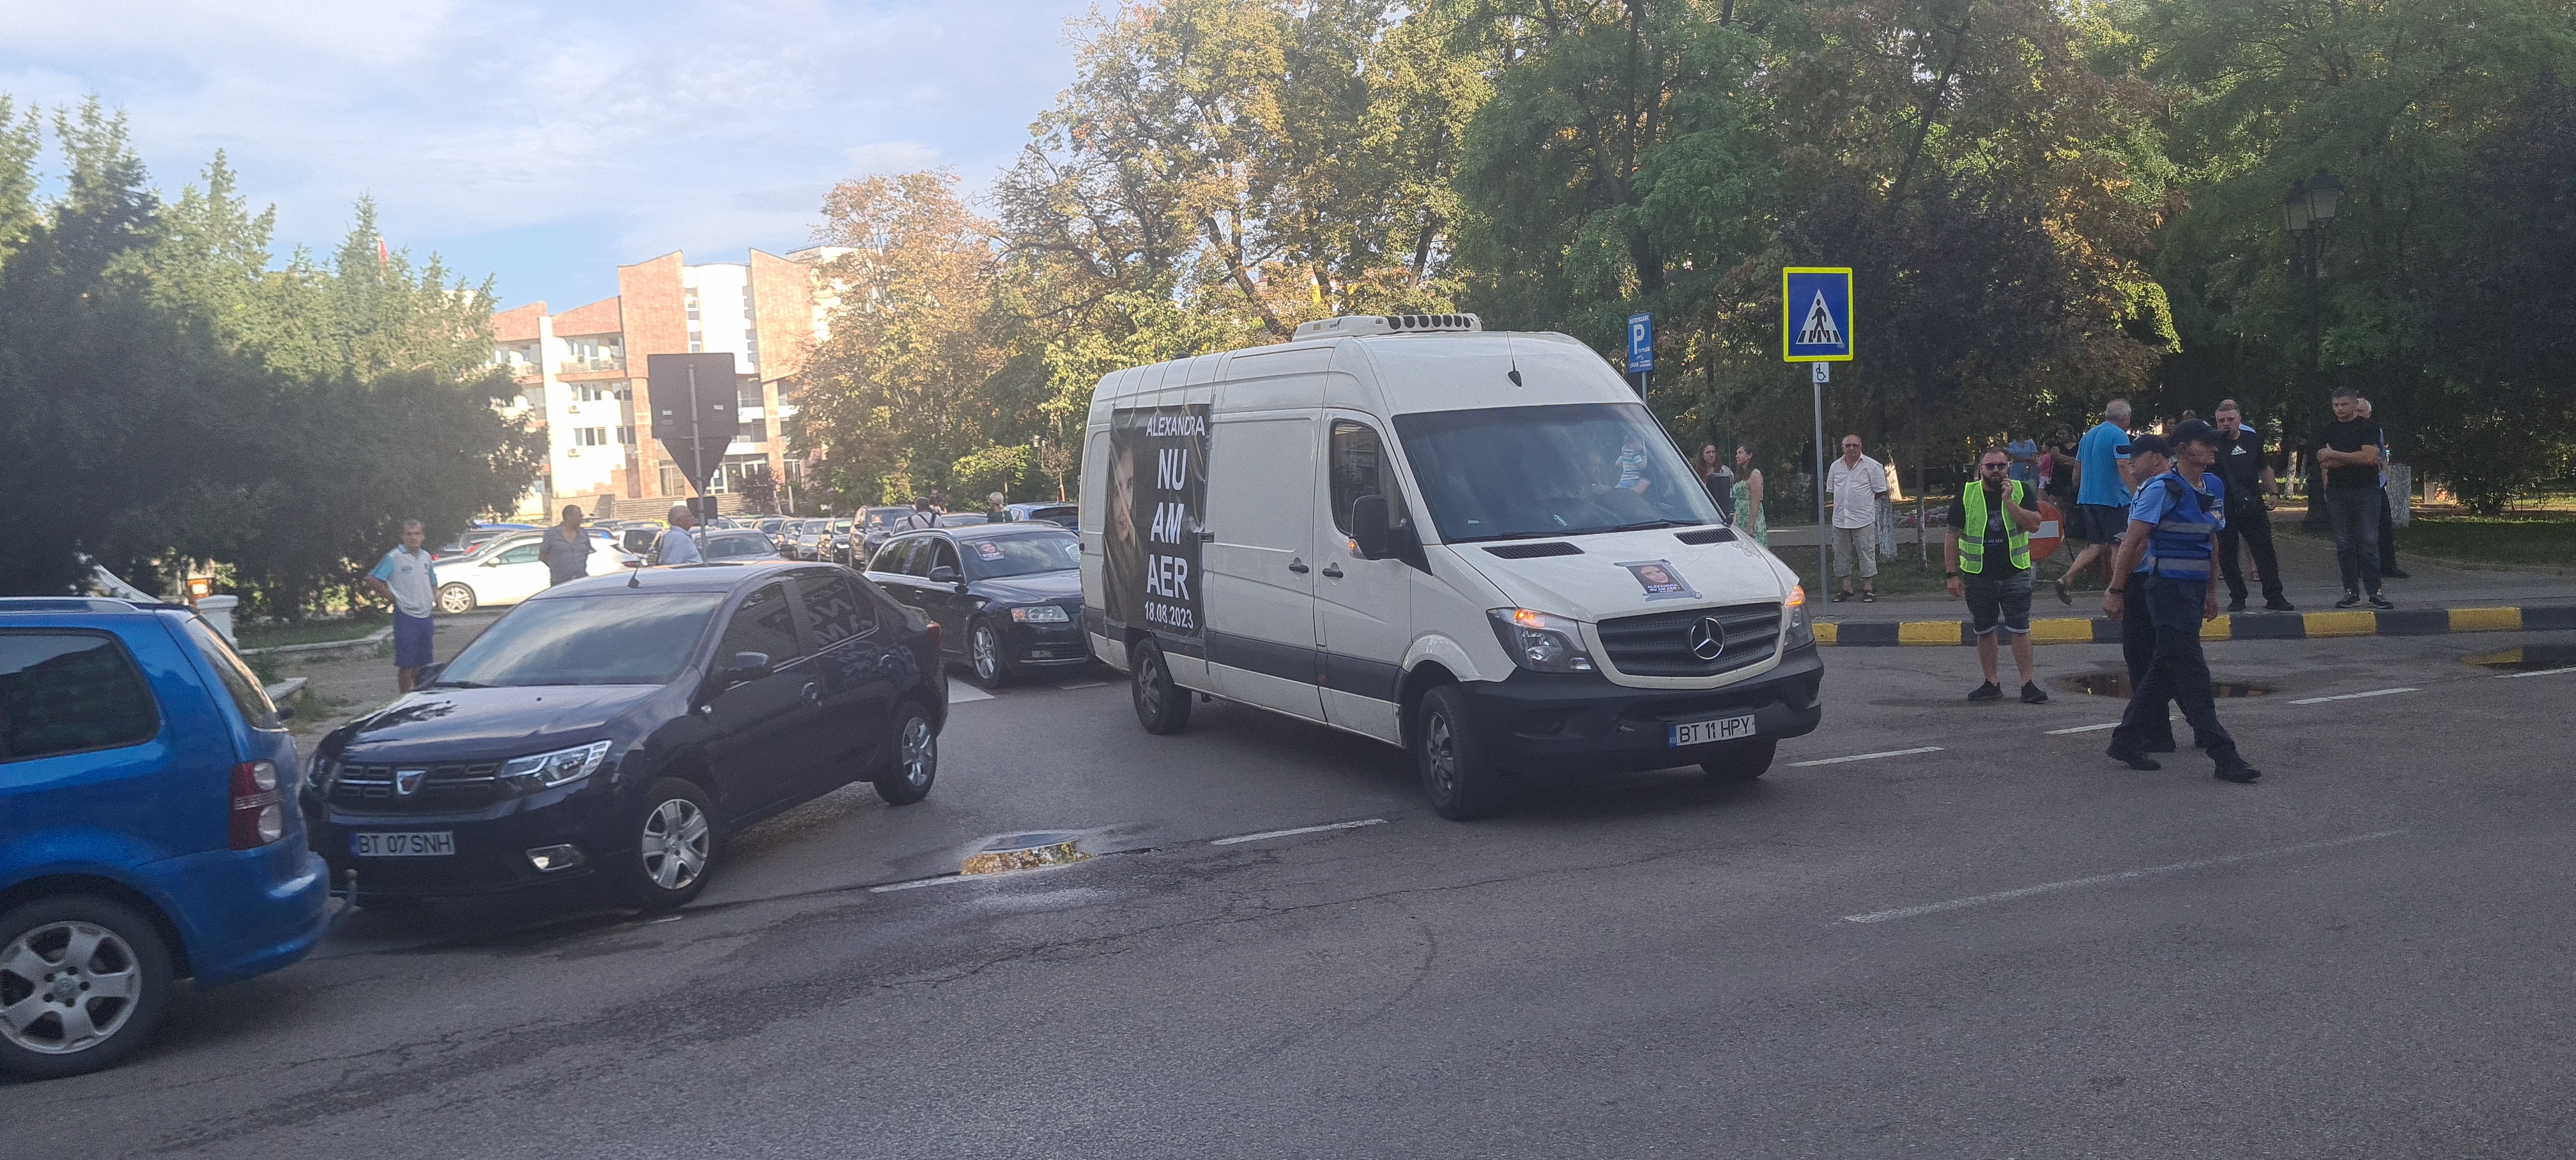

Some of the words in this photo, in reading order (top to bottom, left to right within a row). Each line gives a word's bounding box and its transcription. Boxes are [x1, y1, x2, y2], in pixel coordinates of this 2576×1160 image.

[1634, 324, 1645, 355] P
[1146, 415, 1206, 437] ALEXANDRA
[1157, 448, 1188, 491] NU
[1150, 502, 1184, 545] AM
[1146, 554, 1190, 600] AER
[1144, 601, 1194, 629] 18.08.2023
[1679, 724, 1699, 743] BT
[1705, 722, 1716, 739] 11
[1721, 717, 1750, 737] HPY
[358, 835, 379, 853] BT
[387, 835, 406, 853] 07
[410, 834, 452, 853] SNH
